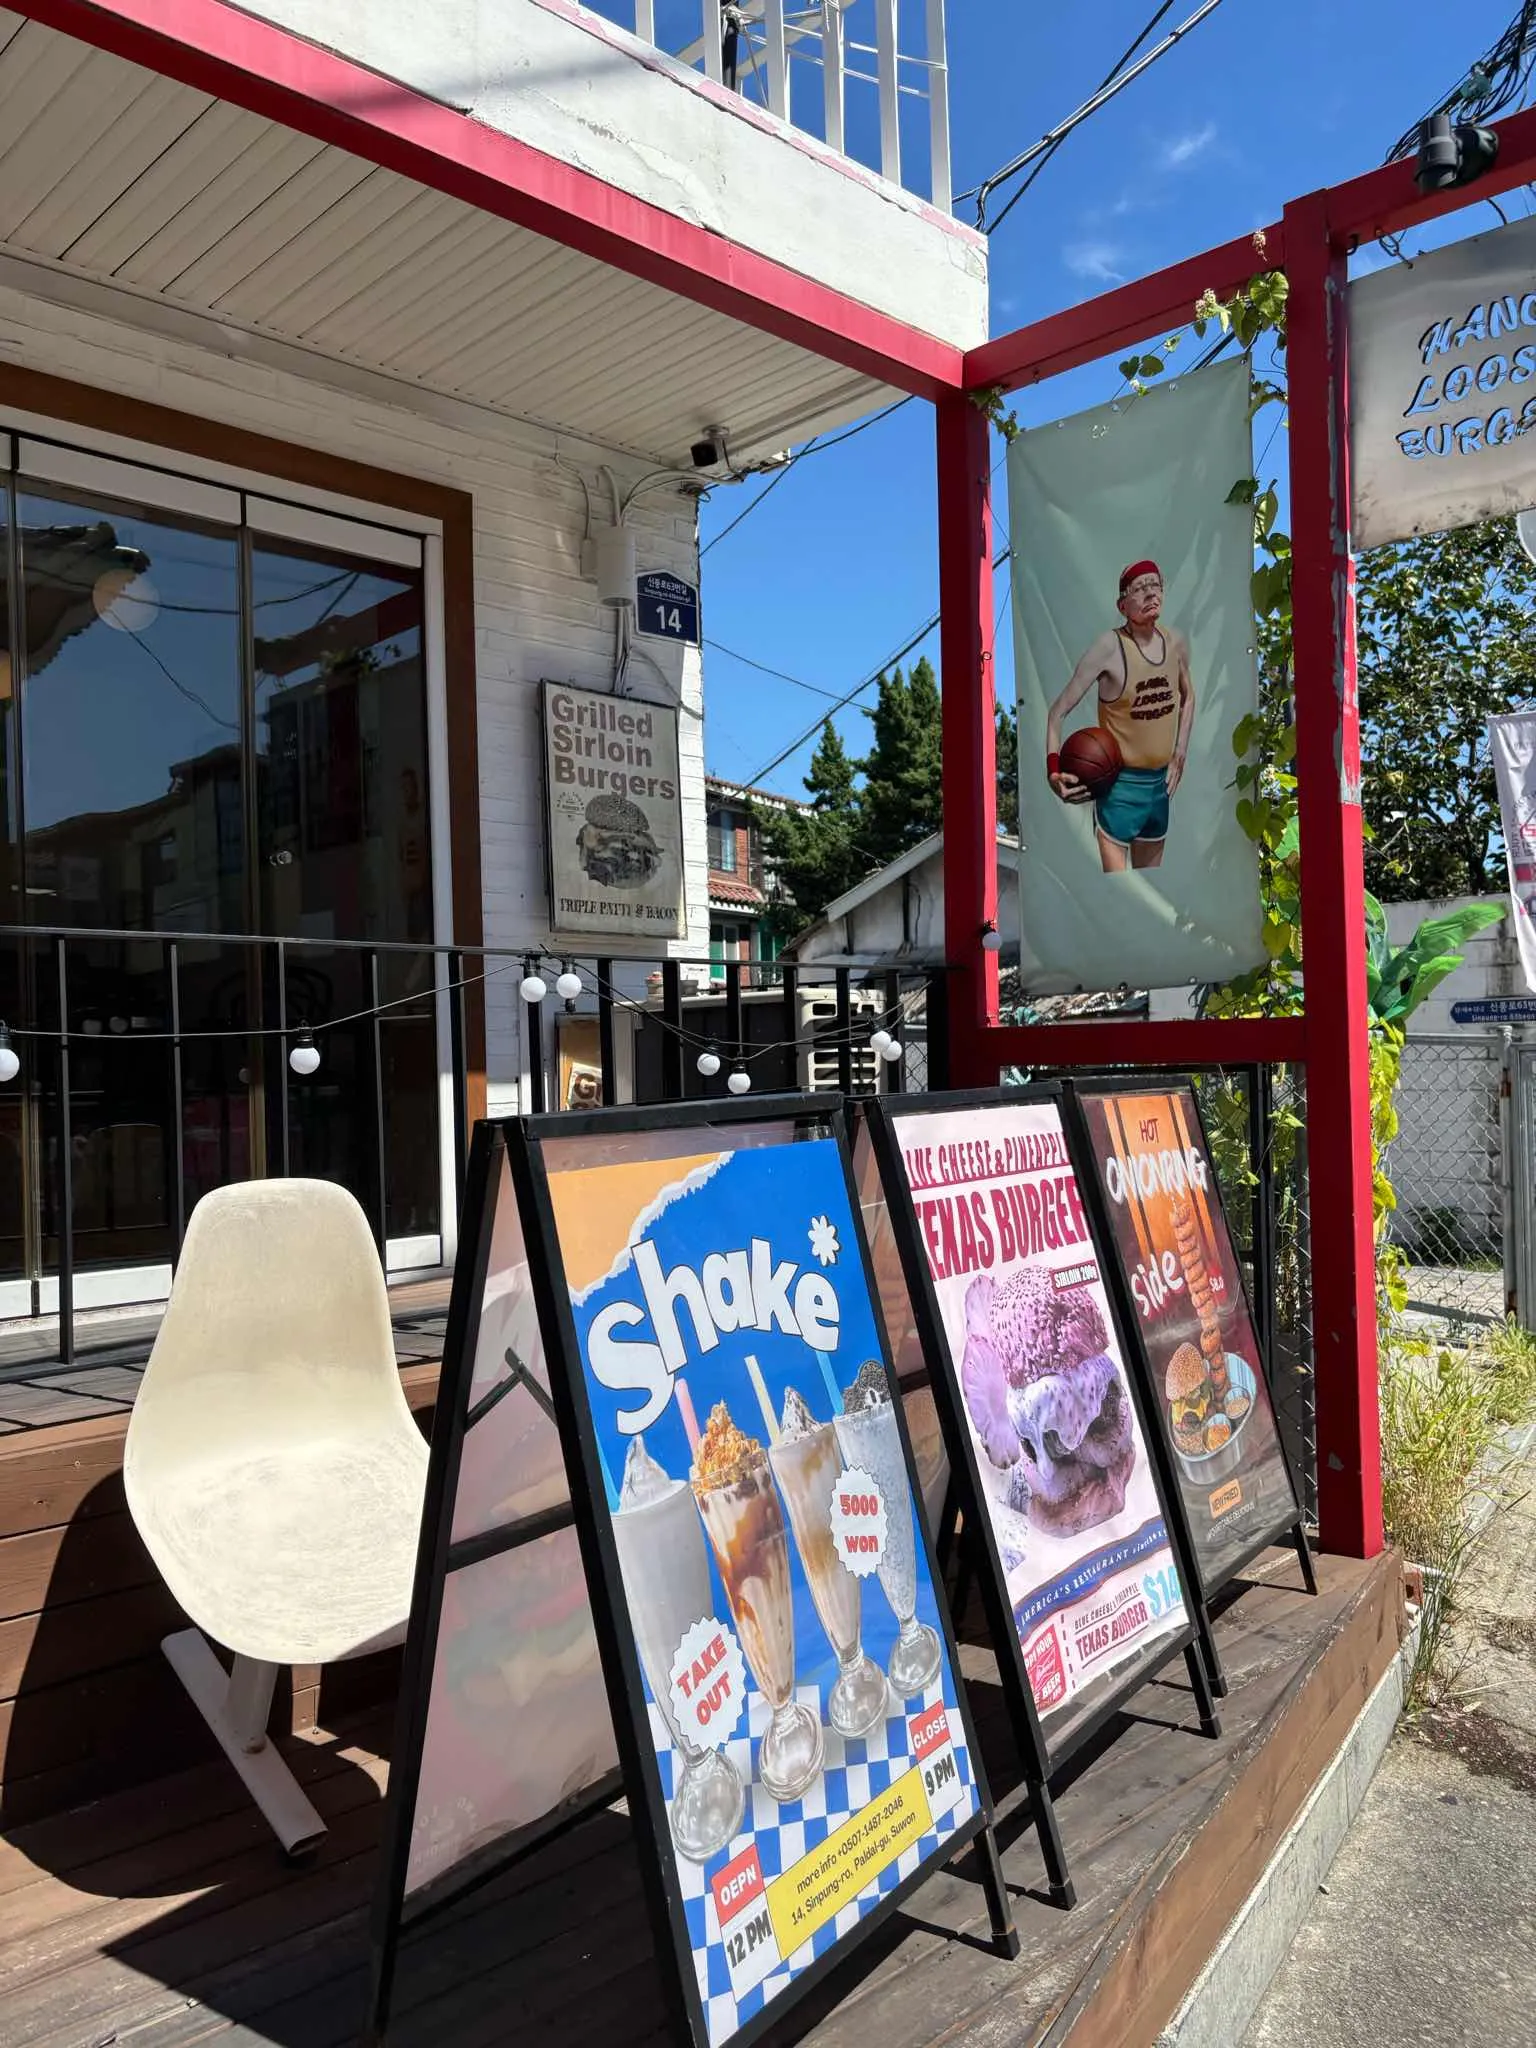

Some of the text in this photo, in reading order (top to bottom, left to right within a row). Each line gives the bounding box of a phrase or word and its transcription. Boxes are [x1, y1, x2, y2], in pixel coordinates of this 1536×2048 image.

[656, 605, 682, 632] 14
[551, 693, 653, 739] Grilled
[551, 723, 652, 768] Sirloin
[554, 755, 675, 800] Burgers
[560, 897, 597, 914] TRIPLE
[1139, 1118, 1159, 1143] HOT
[938, 1140, 993, 1184] CHEESE
[994, 1149, 1004, 1175] &
[1054, 1268, 1081, 1288] SIRLOIN
[840, 1494, 879, 1516] 5000
[1074, 1614, 1089, 1629] BLUE
[1075, 1601, 1148, 1662] TEXAS BURGER
[677, 1632, 728, 1698] TAKE
[696, 1671, 732, 1726] OUT
[913, 1716, 948, 1749] CLOSE
[925, 1753, 956, 1797] 9 PM
[796, 1795, 904, 1895] more info +0507-1487-2046
[720, 1864, 757, 1906] OEPN
[791, 1909, 806, 1926] 14,
[854, 1834, 892, 1871] Paldal-gu,
[889, 1811, 916, 1839] Suwon
[727, 1909, 773, 1969] 12 PM
